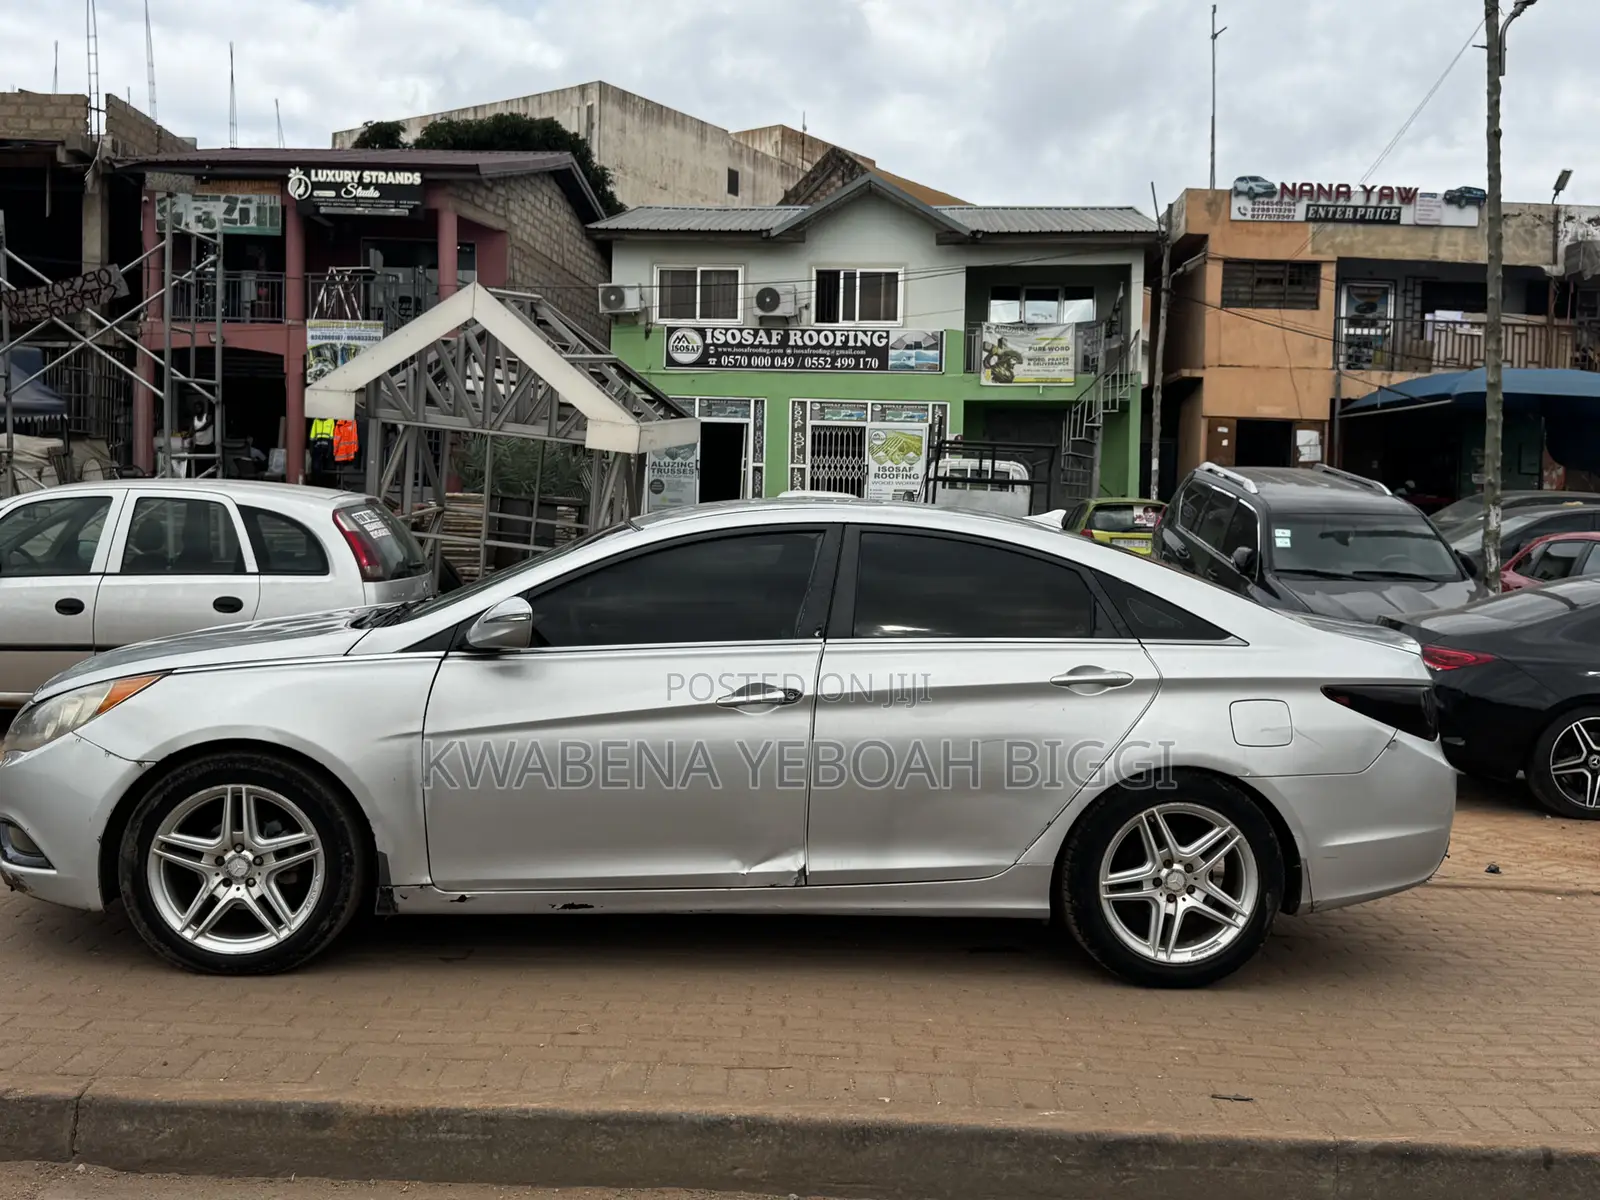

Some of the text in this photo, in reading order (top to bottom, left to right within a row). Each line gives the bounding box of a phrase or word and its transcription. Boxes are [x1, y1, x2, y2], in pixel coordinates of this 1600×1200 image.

[310, 169, 422, 185] LUXURY STRANDS
[340, 182, 380, 198] Studio
[1278, 181, 1420, 206] NANA YAW
[704, 328, 889, 348] ISOSAF ROOFING
[671, 344, 701, 353] ISOSAF
[721, 355, 879, 369] 0570 000 049 / 0552 499 170
[873, 472, 920, 480] ROOFING
